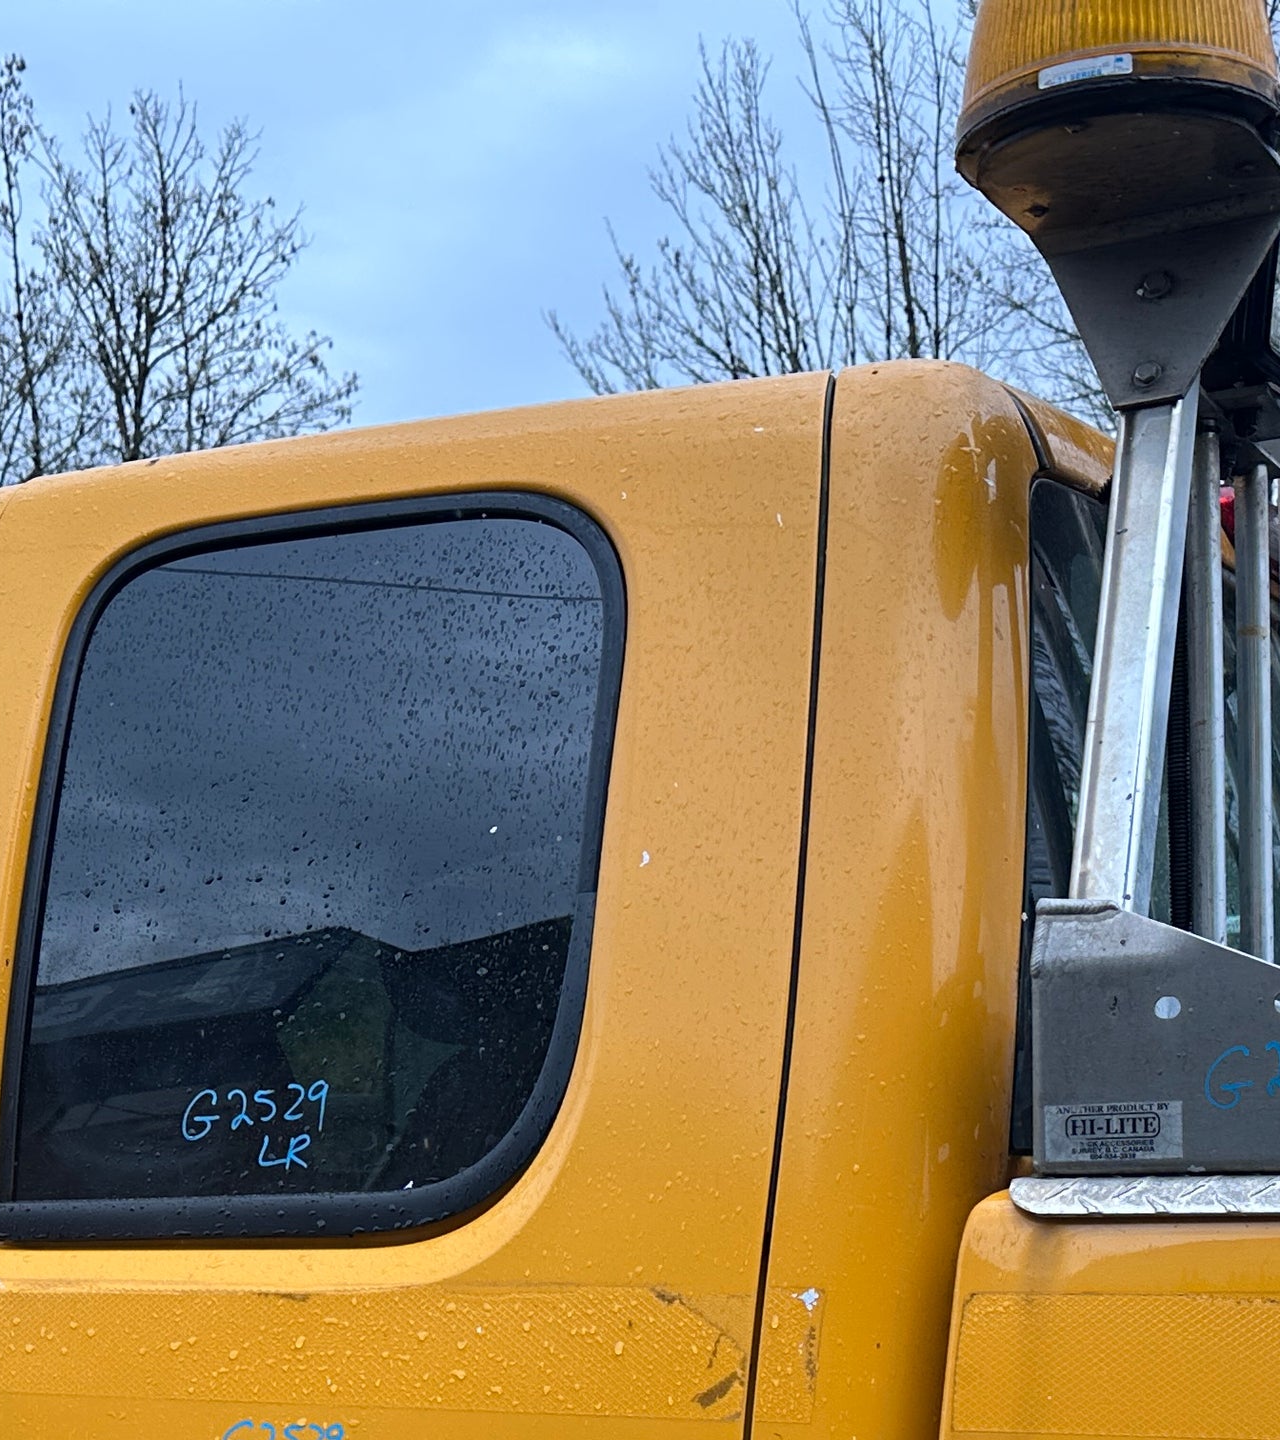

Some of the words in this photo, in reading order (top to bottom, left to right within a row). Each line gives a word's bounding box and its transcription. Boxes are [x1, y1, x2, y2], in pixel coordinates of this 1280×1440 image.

[182, 1079, 329, 1141] G2529
[1107, 1103, 1154, 1113] PRODUCT
[1157, 1102, 1170, 1110] BY
[1070, 1116, 1157, 1136] HI-LITE
[258, 1133, 311, 1170] LR
